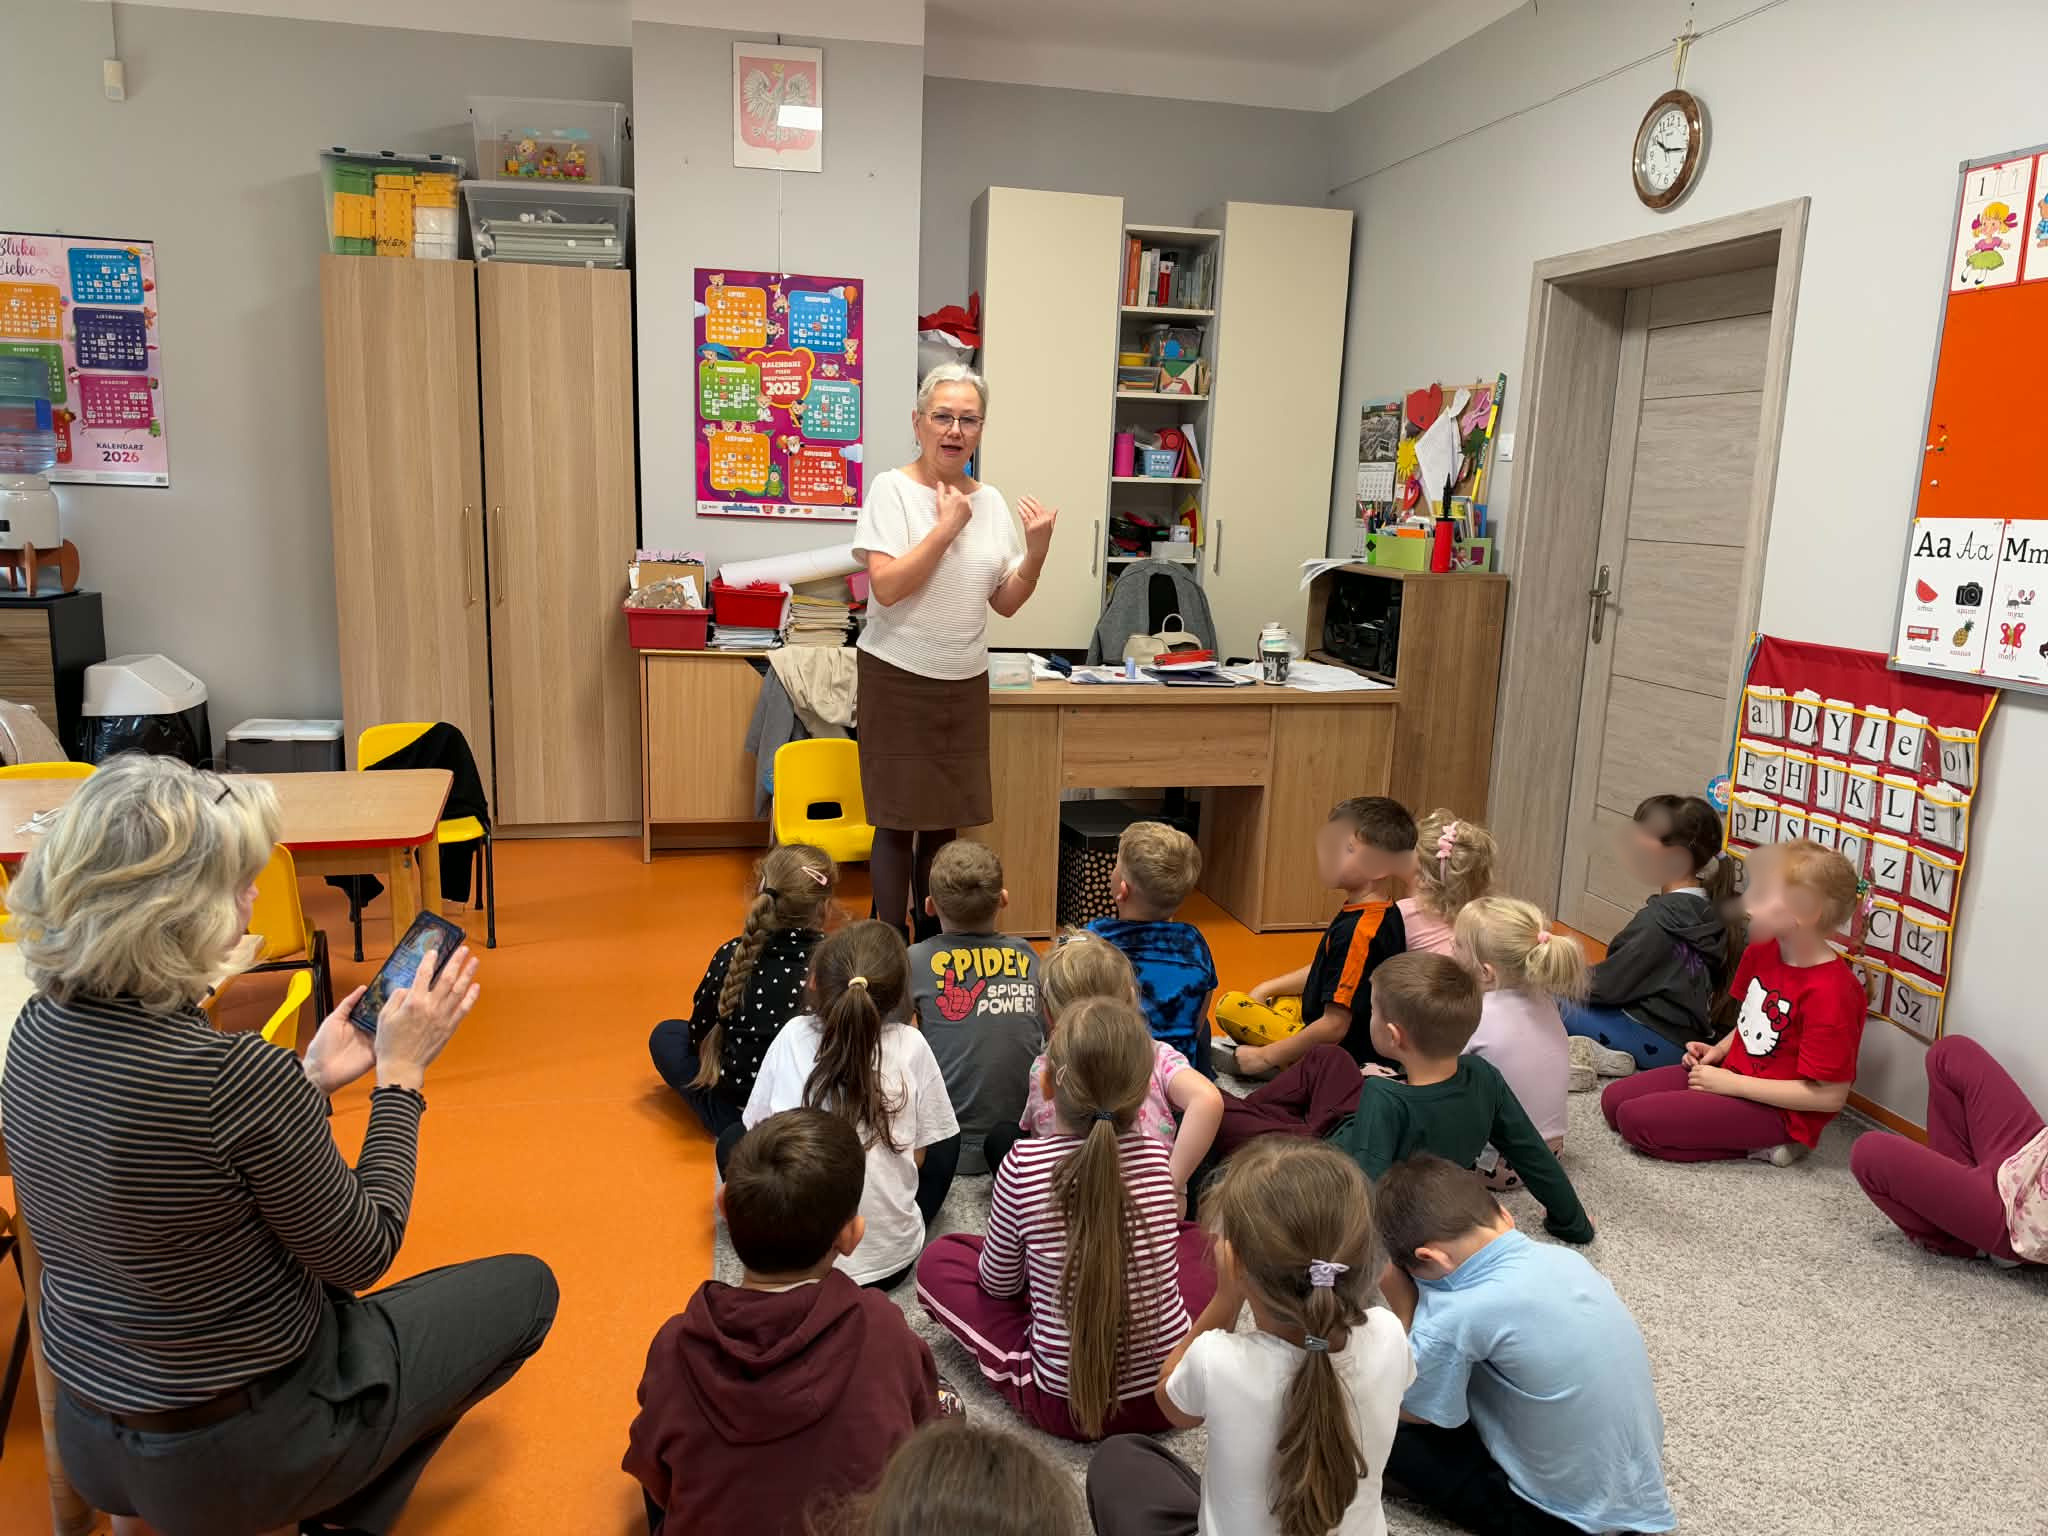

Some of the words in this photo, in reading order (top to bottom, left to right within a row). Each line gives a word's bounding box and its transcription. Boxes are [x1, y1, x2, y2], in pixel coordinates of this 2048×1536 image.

[1979, 177, 1985, 196] 1
[766, 382, 800, 395] 2025
[96, 442, 144, 450] KALENDARZ
[102, 450, 140, 462] 2026
[1914, 530, 1952, 558] Aa
[1956, 530, 1994, 560] Aa
[2003, 537, 2048, 564] Mm
[1752, 705, 1762, 724] a
[1792, 705, 1813, 732] D
[1829, 713, 1848, 742] Y
[1867, 720, 1880, 750] I
[1899, 735, 1912, 756] e
[1742, 752, 1755, 777] F
[1763, 764, 1778, 790] g
[1785, 761, 1804, 790] H
[1820, 770, 1829, 796] J
[1848, 778, 1866, 810] K
[1886, 788, 1905, 819] L
[1735, 812, 1746, 837] p
[1752, 808, 1768, 832] P
[1786, 818, 1799, 840] S
[1880, 858, 1898, 880] z
[1919, 861, 1945, 895] W
[1869, 910, 1892, 940] C
[1906, 924, 1934, 960] dz
[930, 946, 1030, 989] SPIDEY
[987, 984, 1036, 998] SPIDER
[1896, 985, 1924, 1023] Sz
